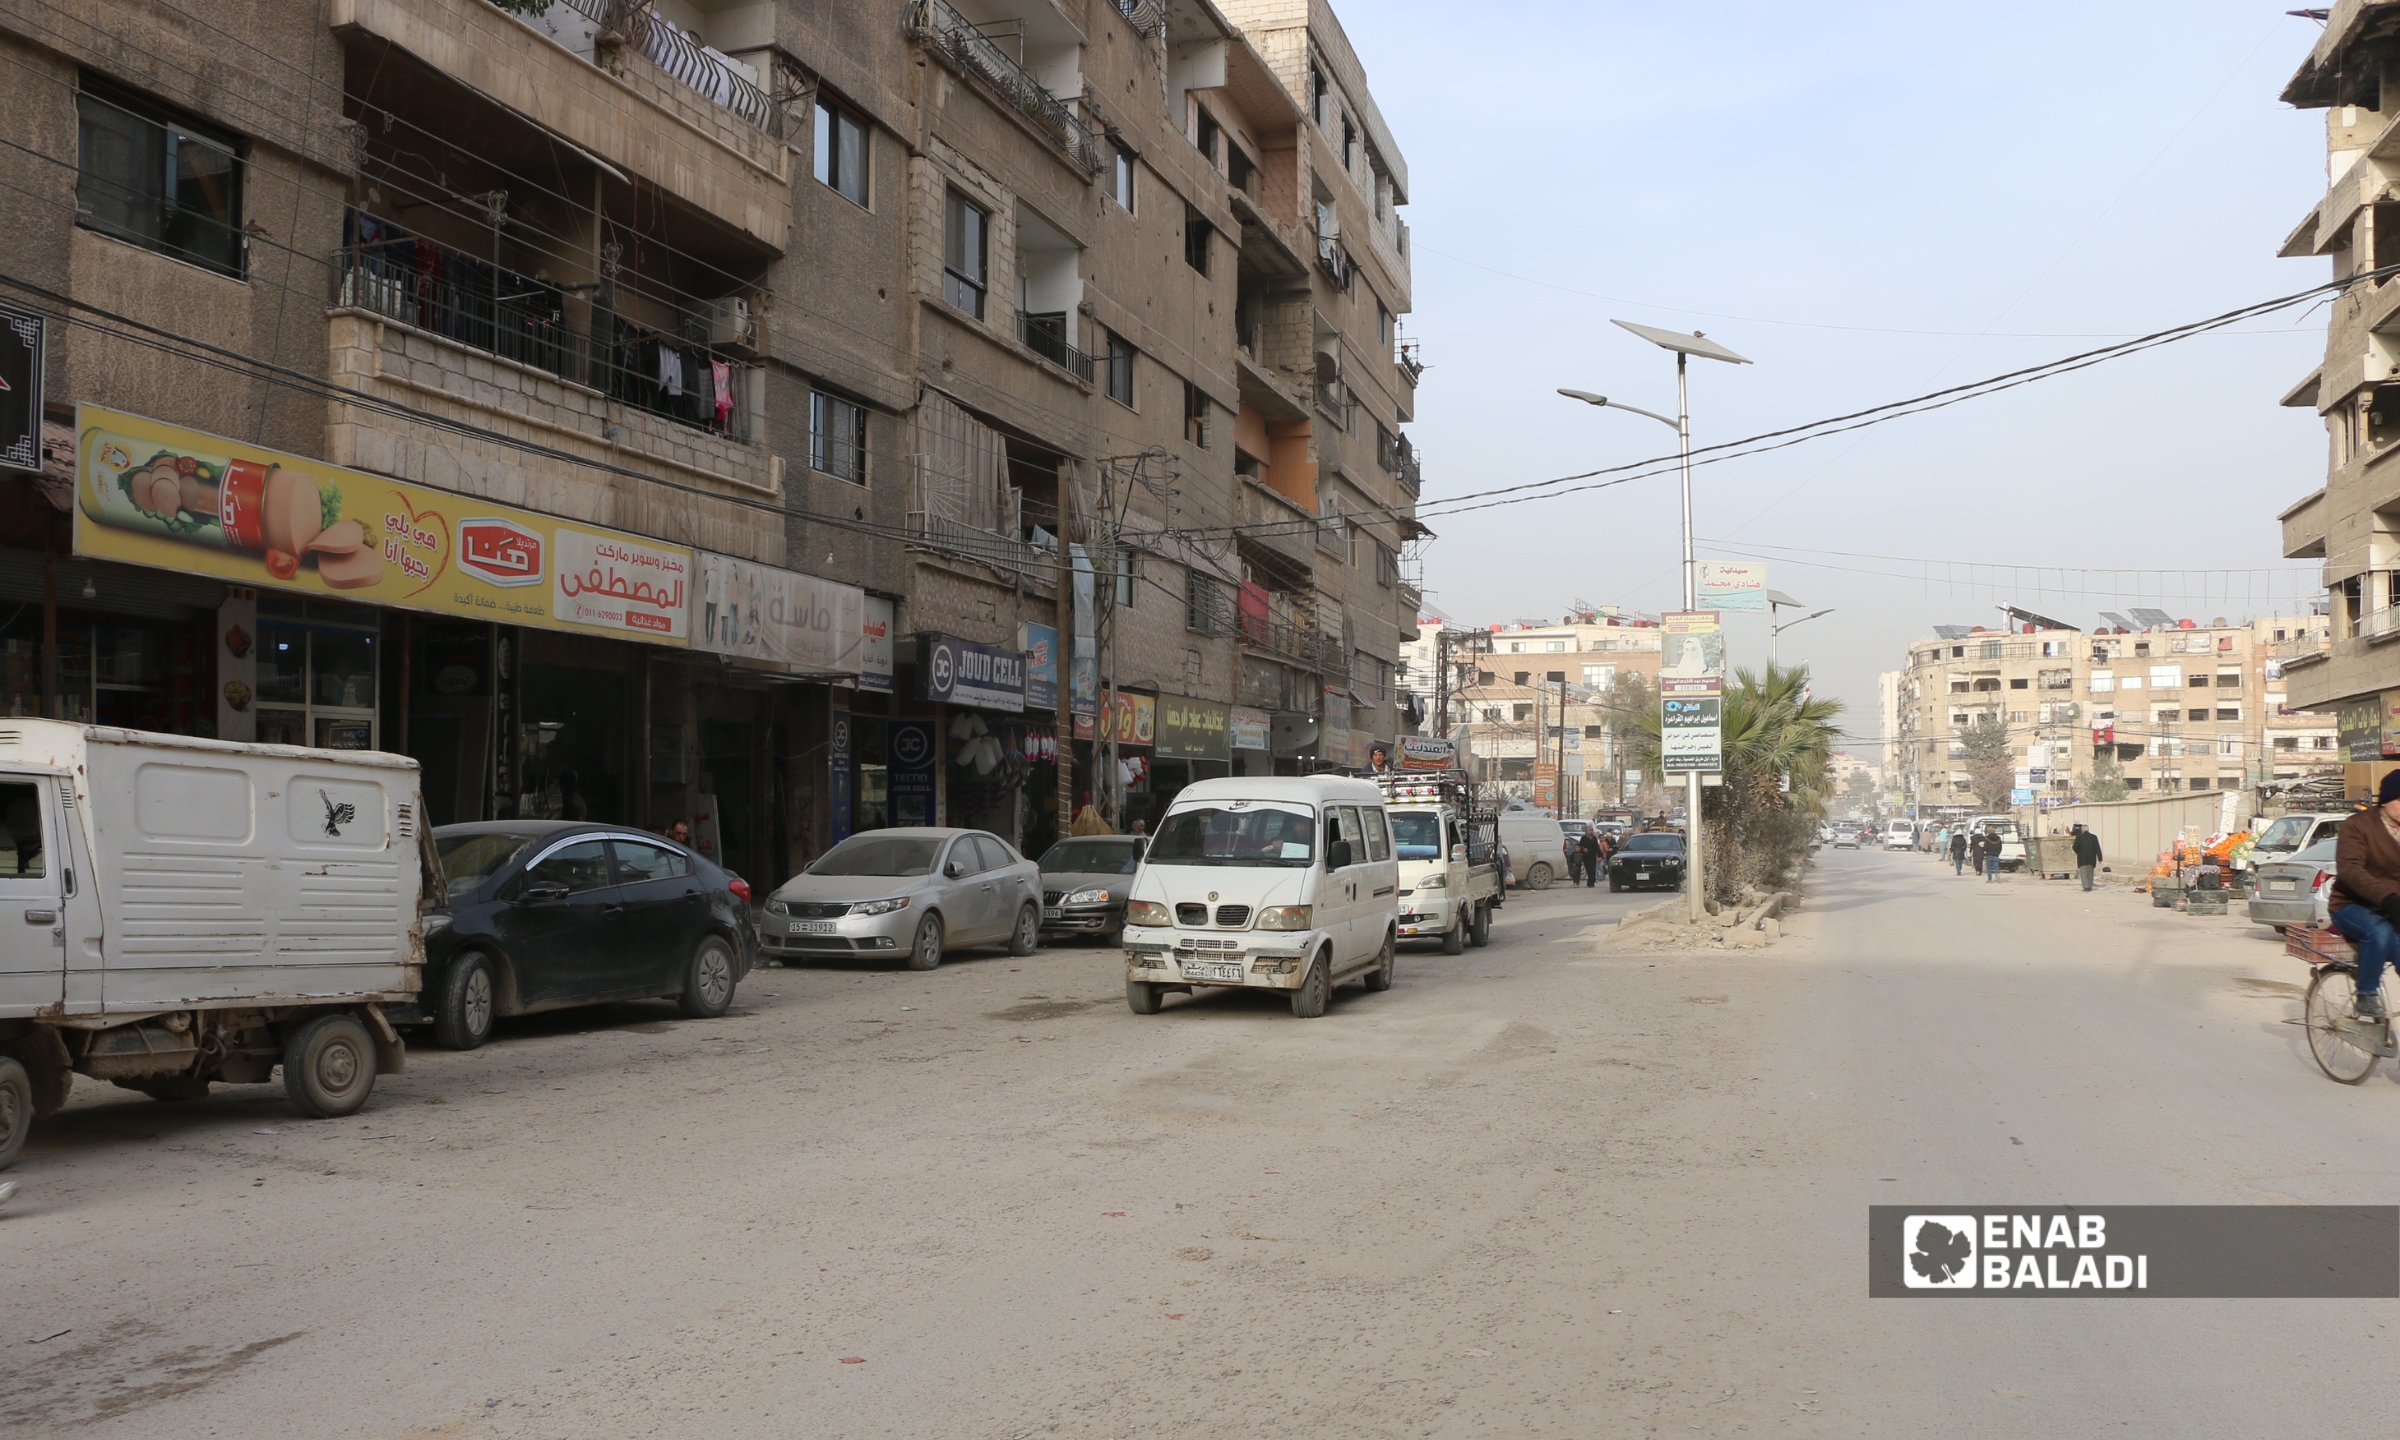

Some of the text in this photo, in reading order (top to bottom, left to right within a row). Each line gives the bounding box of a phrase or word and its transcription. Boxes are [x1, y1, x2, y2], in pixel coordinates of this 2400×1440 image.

[385, 514, 436, 550] هي يلي
[516, 537, 537, 549] مرتديلا
[384, 538, 429, 581] بحبها أنا
[595, 544, 684, 573] مخبز وسوبر ماركت
[1719, 566, 1748, 575] صيدلية
[560, 560, 684, 609] المصطفى
[1734, 580, 1761, 589] هنادي
[454, 593, 473, 606] أكيدة
[475, 596, 496, 609] ضمانة
[524, 604, 545, 616] طعمة
[584, 608, 623, 622] 011 6290033
[652, 618, 666, 630] مواد
[958, 650, 1022, 687] JOUD CELL
[1404, 744, 1446, 754] العندليب
[808, 923, 833, 933] 31912
